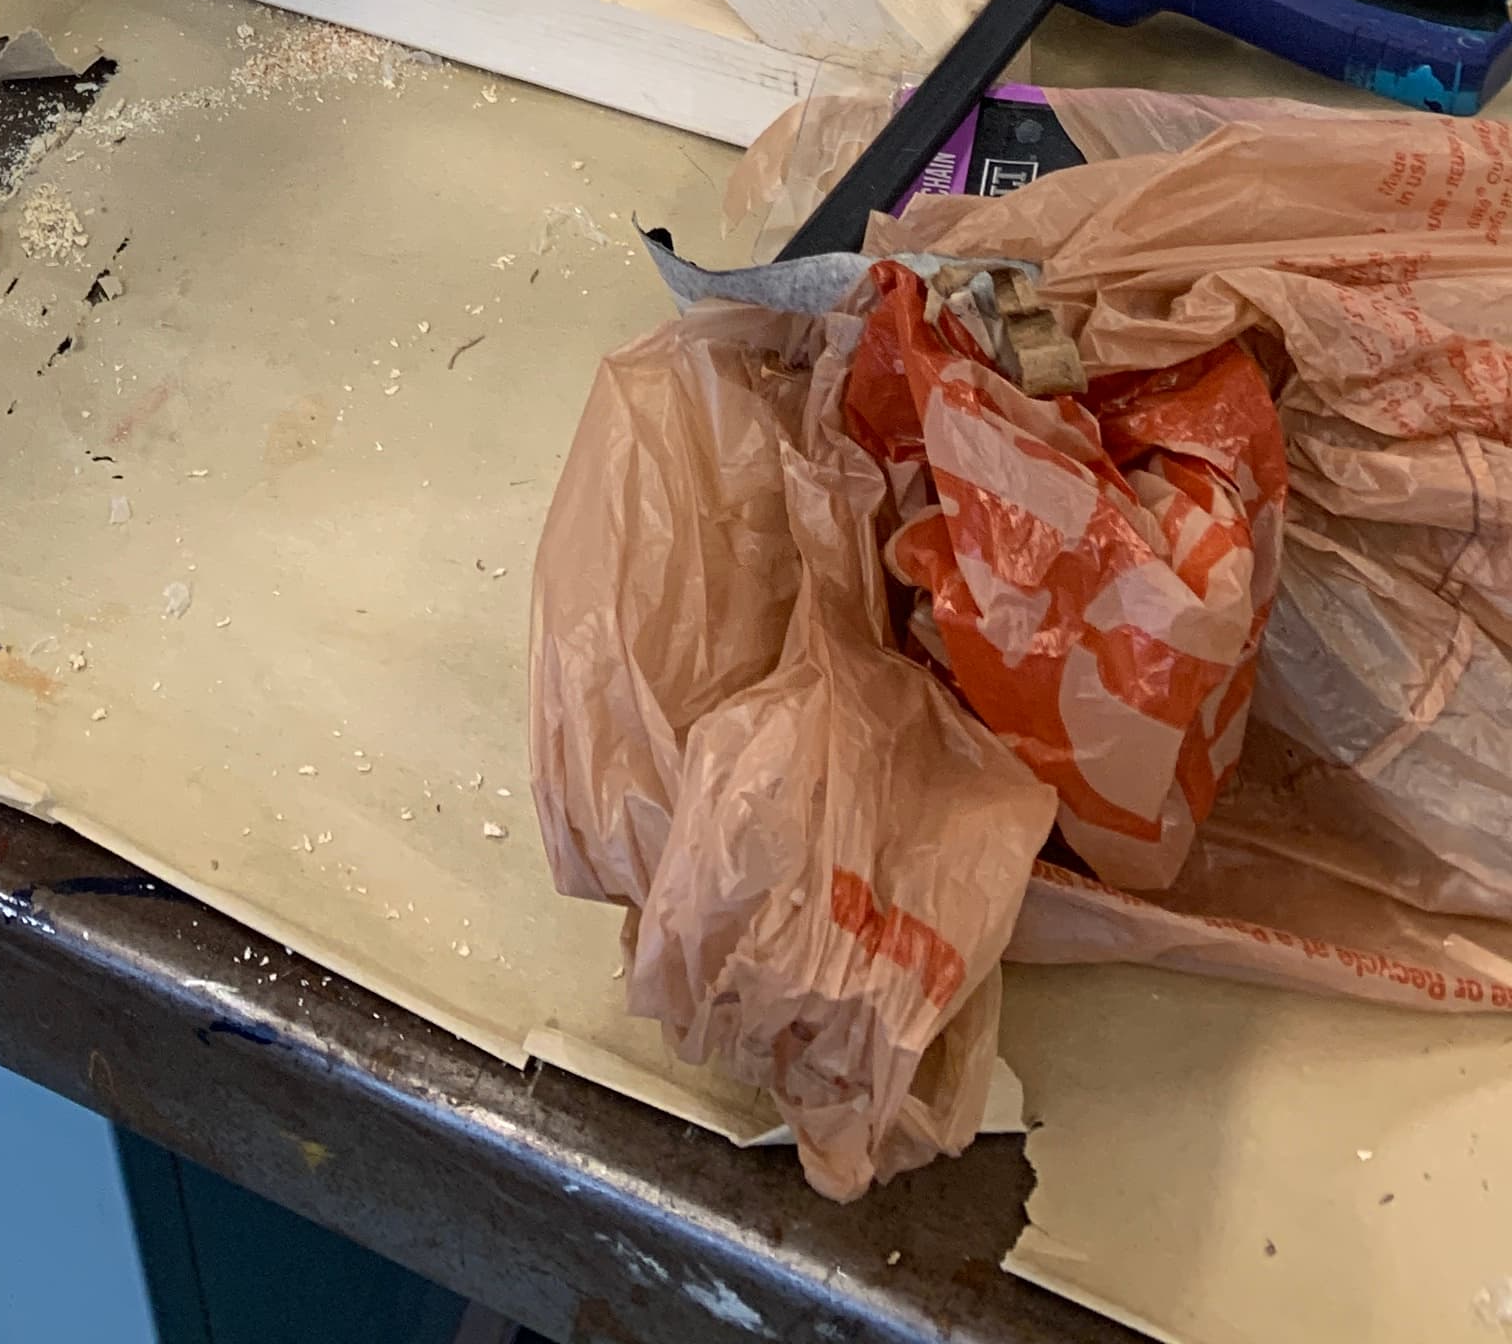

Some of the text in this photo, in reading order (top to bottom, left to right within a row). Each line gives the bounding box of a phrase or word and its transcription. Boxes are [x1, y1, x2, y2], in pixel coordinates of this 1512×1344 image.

[920, 152, 956, 195] CHAIN
[1377, 151, 1407, 196] Made
[1395, 153, 1428, 206] in USA
[1335, 947, 1448, 1002] Recycle
[1454, 976, 1485, 1003] or
